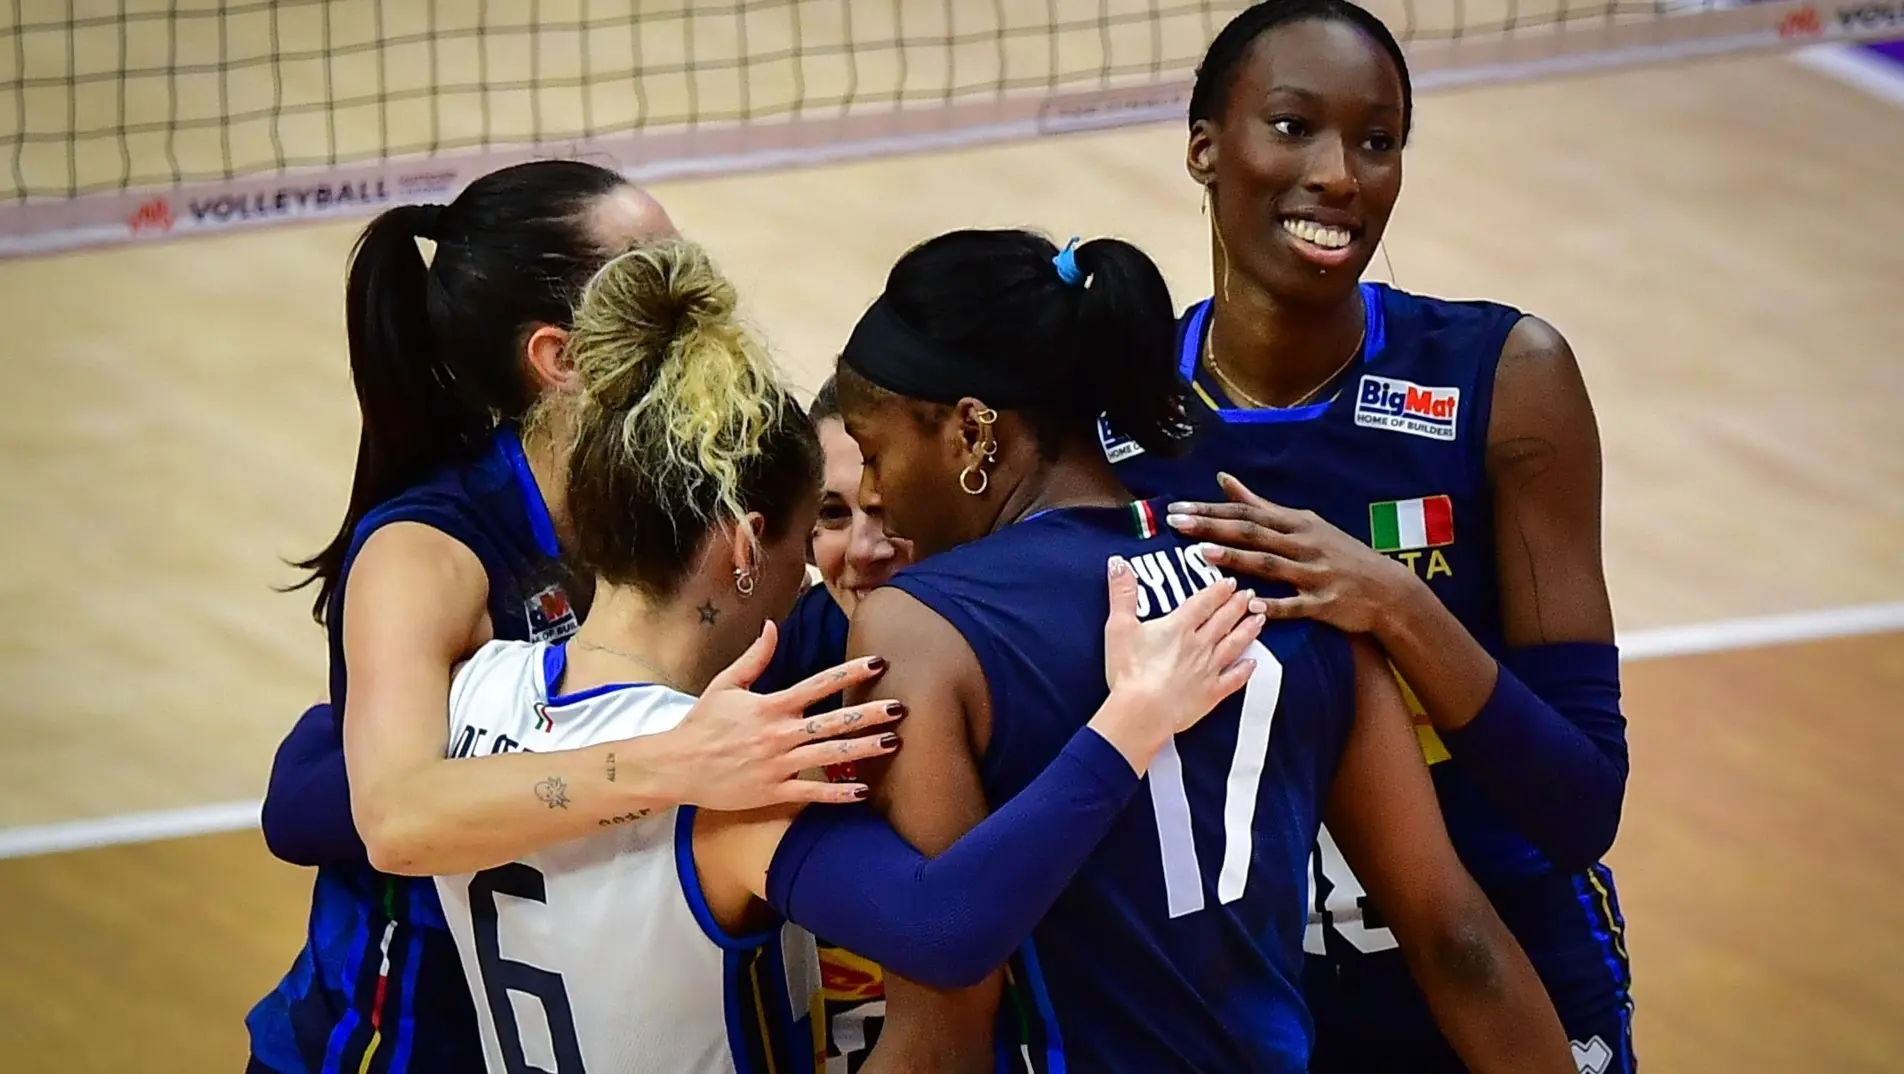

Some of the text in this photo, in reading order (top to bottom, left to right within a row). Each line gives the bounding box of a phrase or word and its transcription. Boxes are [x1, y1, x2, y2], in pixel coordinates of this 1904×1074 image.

[189, 178, 389, 222] VOLLEYBALL
[1360, 379, 1456, 418] BigMat
[1357, 413, 1453, 437] HOME OF BUILDERS
[1398, 549, 1453, 580] TA
[1147, 640, 1283, 918] 17
[468, 861, 587, 1074] 6
